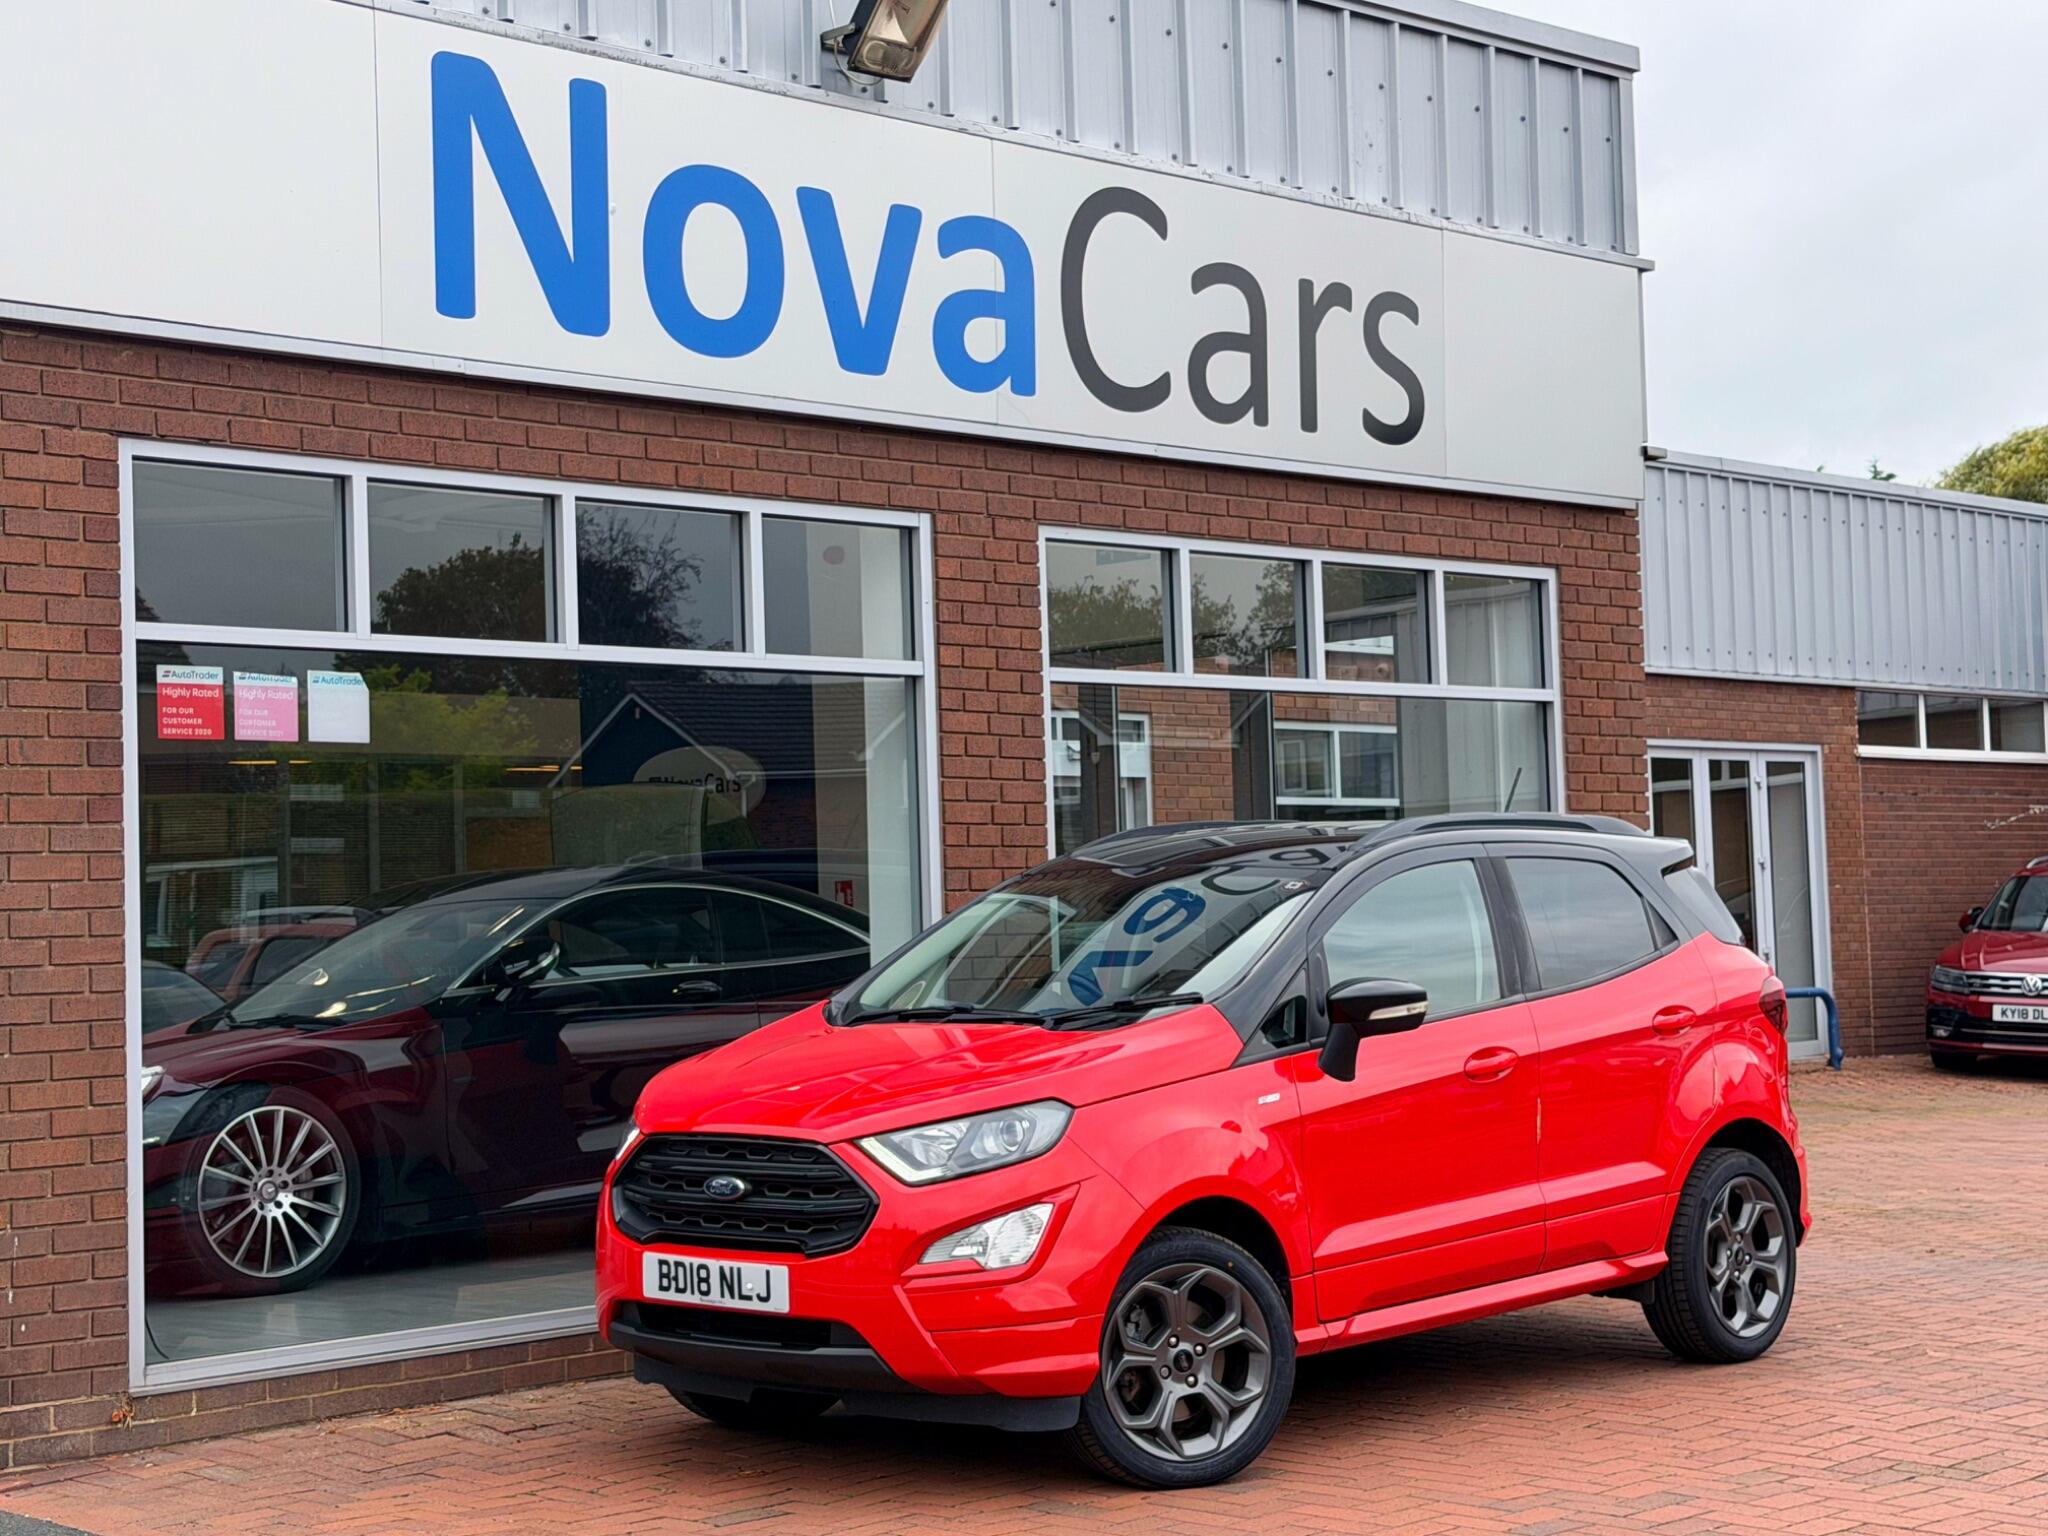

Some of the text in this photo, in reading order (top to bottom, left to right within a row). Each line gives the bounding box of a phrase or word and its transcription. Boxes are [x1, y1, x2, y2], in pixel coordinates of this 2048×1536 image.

[431, 51, 1425, 445] NovaCars
[171, 670, 219, 680] AutoTrader
[321, 676, 363, 685] AutoTrade
[162, 687, 219, 698] Highly Rated
[239, 688, 293, 699] Highly Rated
[162, 717, 202, 725] CUSTOMER
[2001, 1007, 2029, 1019] KY18
[657, 1258, 771, 1303] BD18 NLJ
